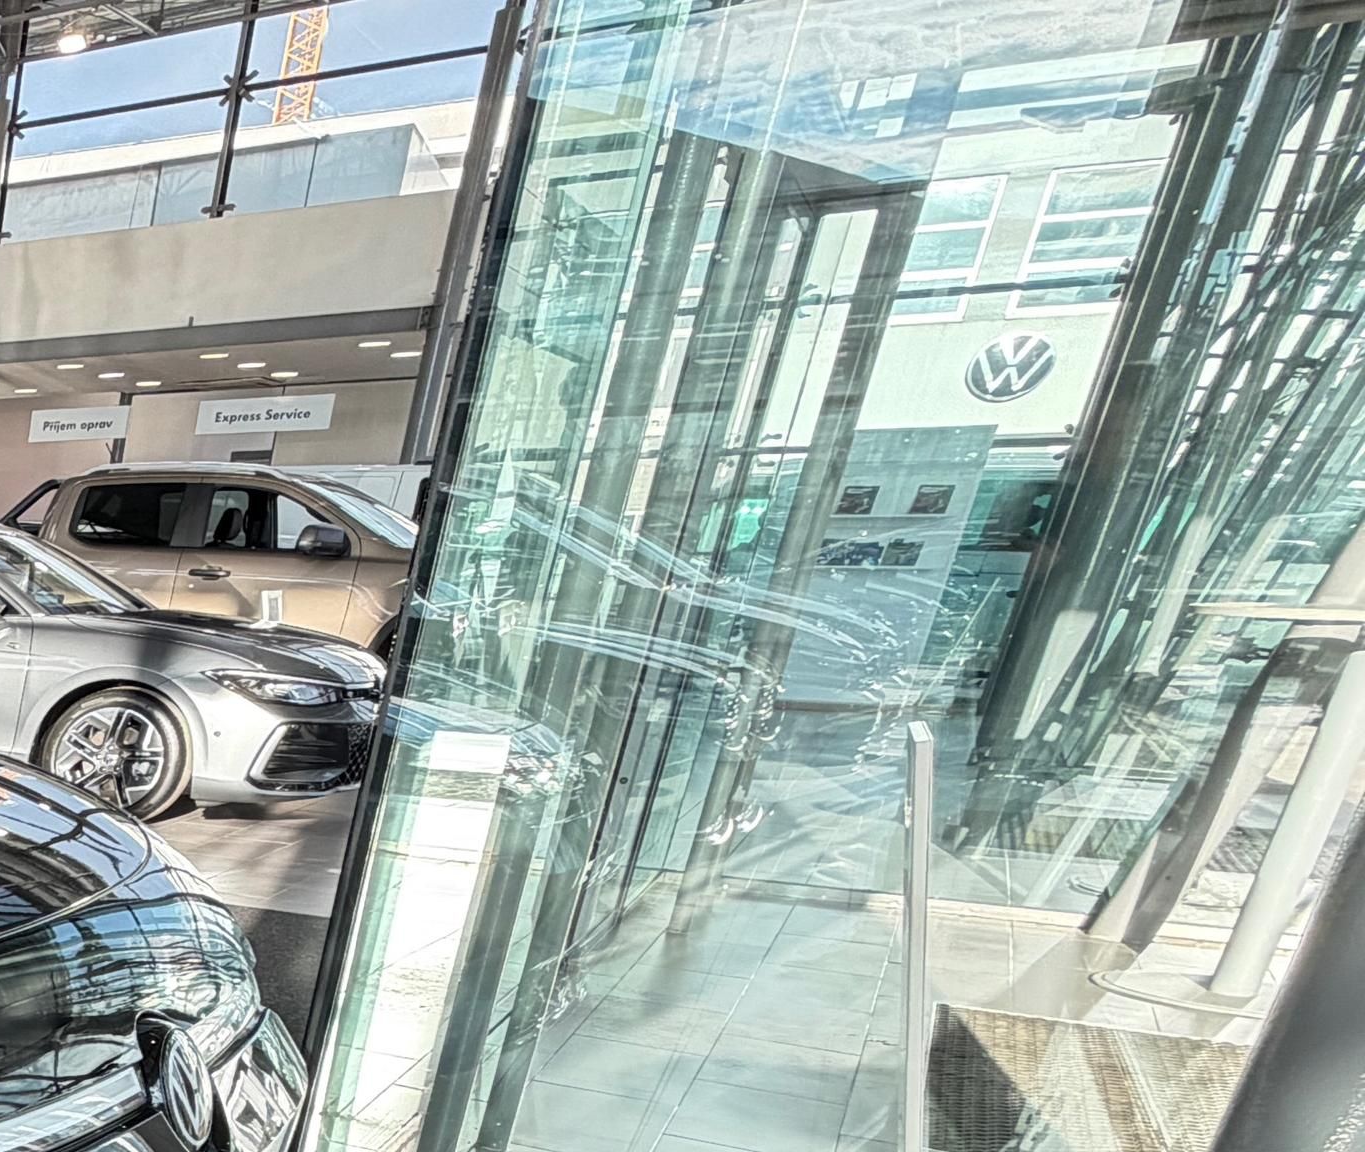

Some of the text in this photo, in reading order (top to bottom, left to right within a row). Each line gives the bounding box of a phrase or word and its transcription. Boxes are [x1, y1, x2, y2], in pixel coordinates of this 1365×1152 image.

[214, 408, 311, 424] Express Service
[80, 420, 113, 432] oprav
